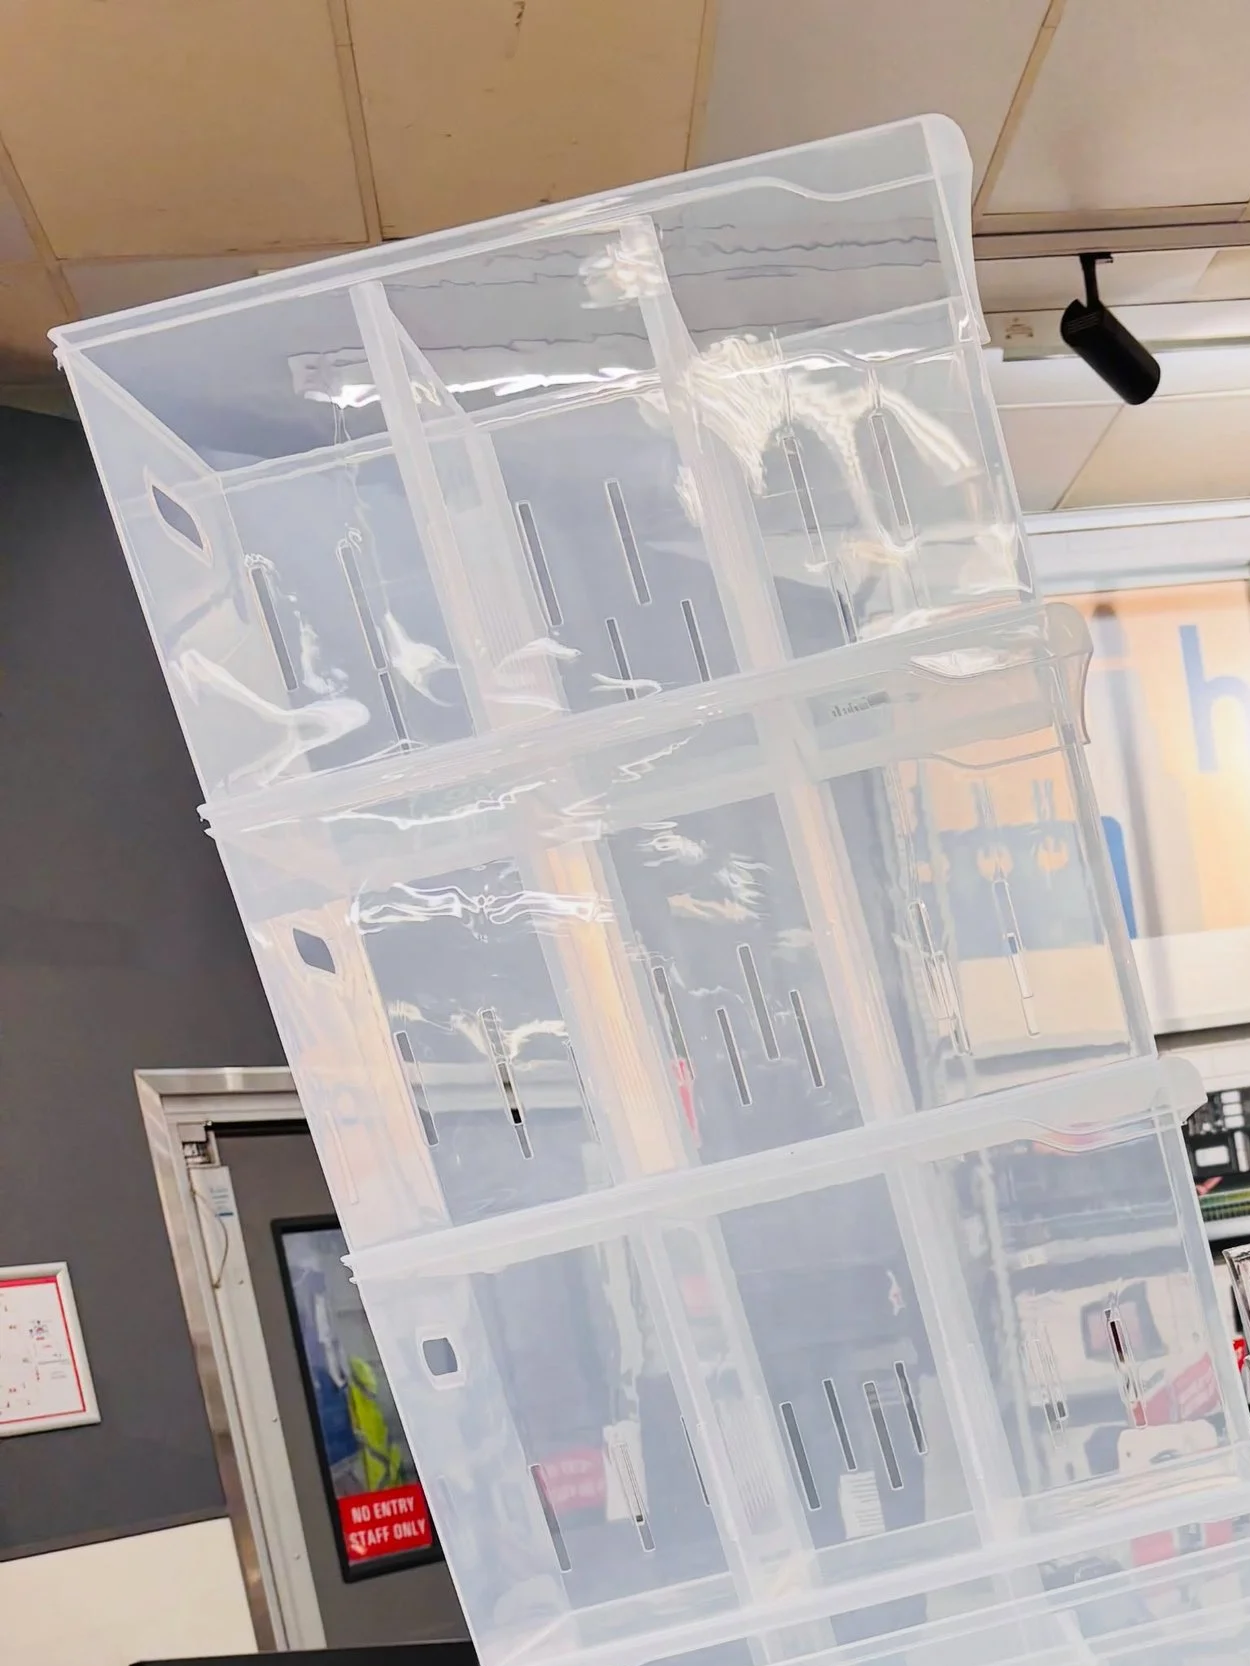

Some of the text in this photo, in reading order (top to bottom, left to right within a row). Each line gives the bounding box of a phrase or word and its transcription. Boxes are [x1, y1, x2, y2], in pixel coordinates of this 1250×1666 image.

[351, 1496, 415, 1524] NO ENTRY
[349, 1518, 426, 1547] STAFF ONLY
